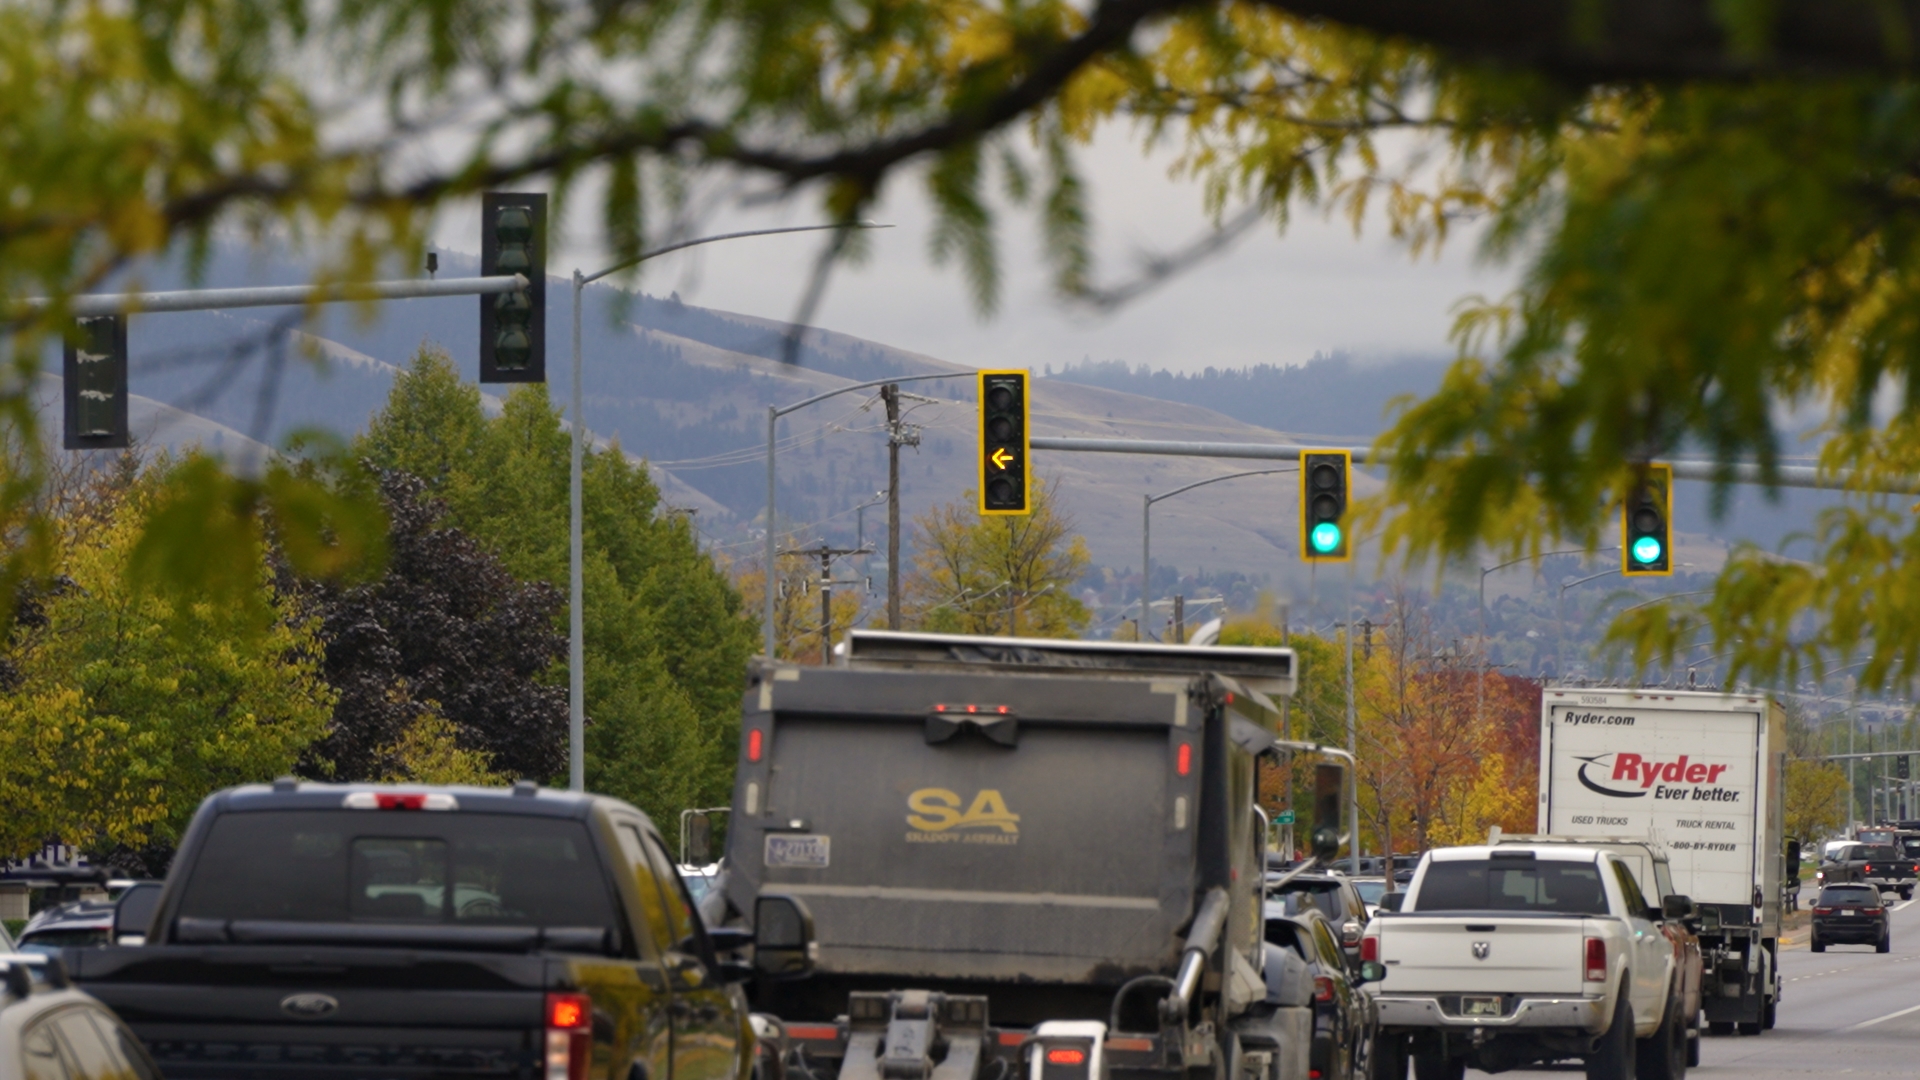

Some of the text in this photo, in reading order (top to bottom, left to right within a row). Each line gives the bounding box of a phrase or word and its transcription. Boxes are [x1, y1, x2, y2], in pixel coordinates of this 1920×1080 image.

[1565, 711, 1635, 726] Ryder.com
[1612, 753, 1727, 788] Ryder
[1655, 785, 1690, 800] Ever
[906, 787, 1020, 833] SA
[1571, 815, 1629, 826] USED TRUCKS
[1676, 819, 1736, 830] TRUCK RENTAL
